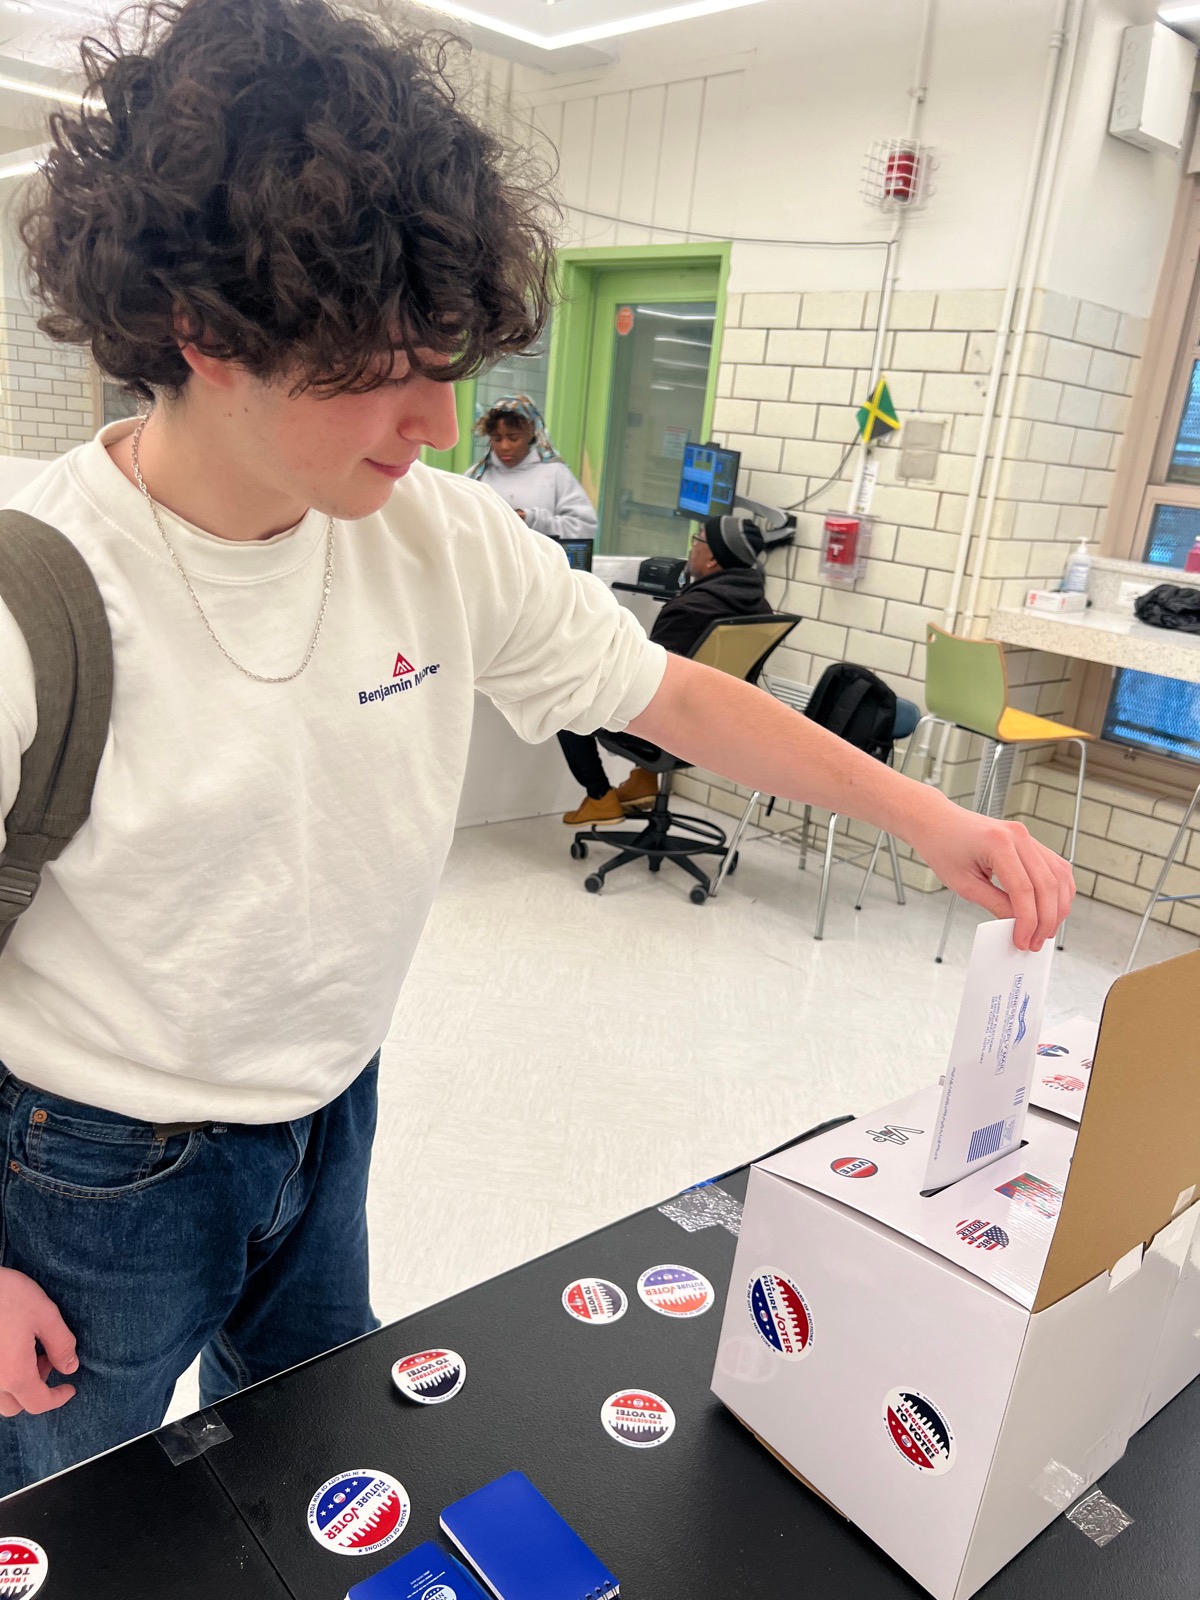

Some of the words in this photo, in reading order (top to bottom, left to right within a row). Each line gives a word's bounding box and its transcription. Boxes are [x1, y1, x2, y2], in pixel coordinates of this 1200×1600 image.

[359, 678, 412, 704] Benjamin
[414, 664, 437, 686] More
[839, 1161, 869, 1174] VOTE
[961, 1221, 985, 1236] VOTER
[978, 1239, 993, 1248] BE
[584, 1285, 591, 1295] TO
[645, 1286, 676, 1296] VOTER
[587, 1295, 599, 1315] VOTE!
[762, 1275, 778, 1311] FUTURE
[775, 1312, 793, 1353] VOTER
[406, 1363, 435, 1377] VOTE!
[411, 1365, 448, 1382] REGISTERED
[616, 1409, 646, 1418] VOTE!
[616, 1416, 657, 1424] REGISTERED
[896, 1406, 908, 1422] TO
[909, 1423, 935, 1459] VOTE!
[904, 1408, 939, 1454] REGISTERED
[321, 1484, 328, 1492] OF
[328, 1477, 340, 1486] CITY
[356, 1480, 385, 1508] FUTURE
[382, 1484, 391, 1494] I'M
[313, 1492, 322, 1503] NEW
[324, 1506, 360, 1540] VOTER
[398, 1510, 407, 1528] BOARD
[392, 1527, 400, 1536] OF
[364, 1535, 394, 1552] ELECTIONS
